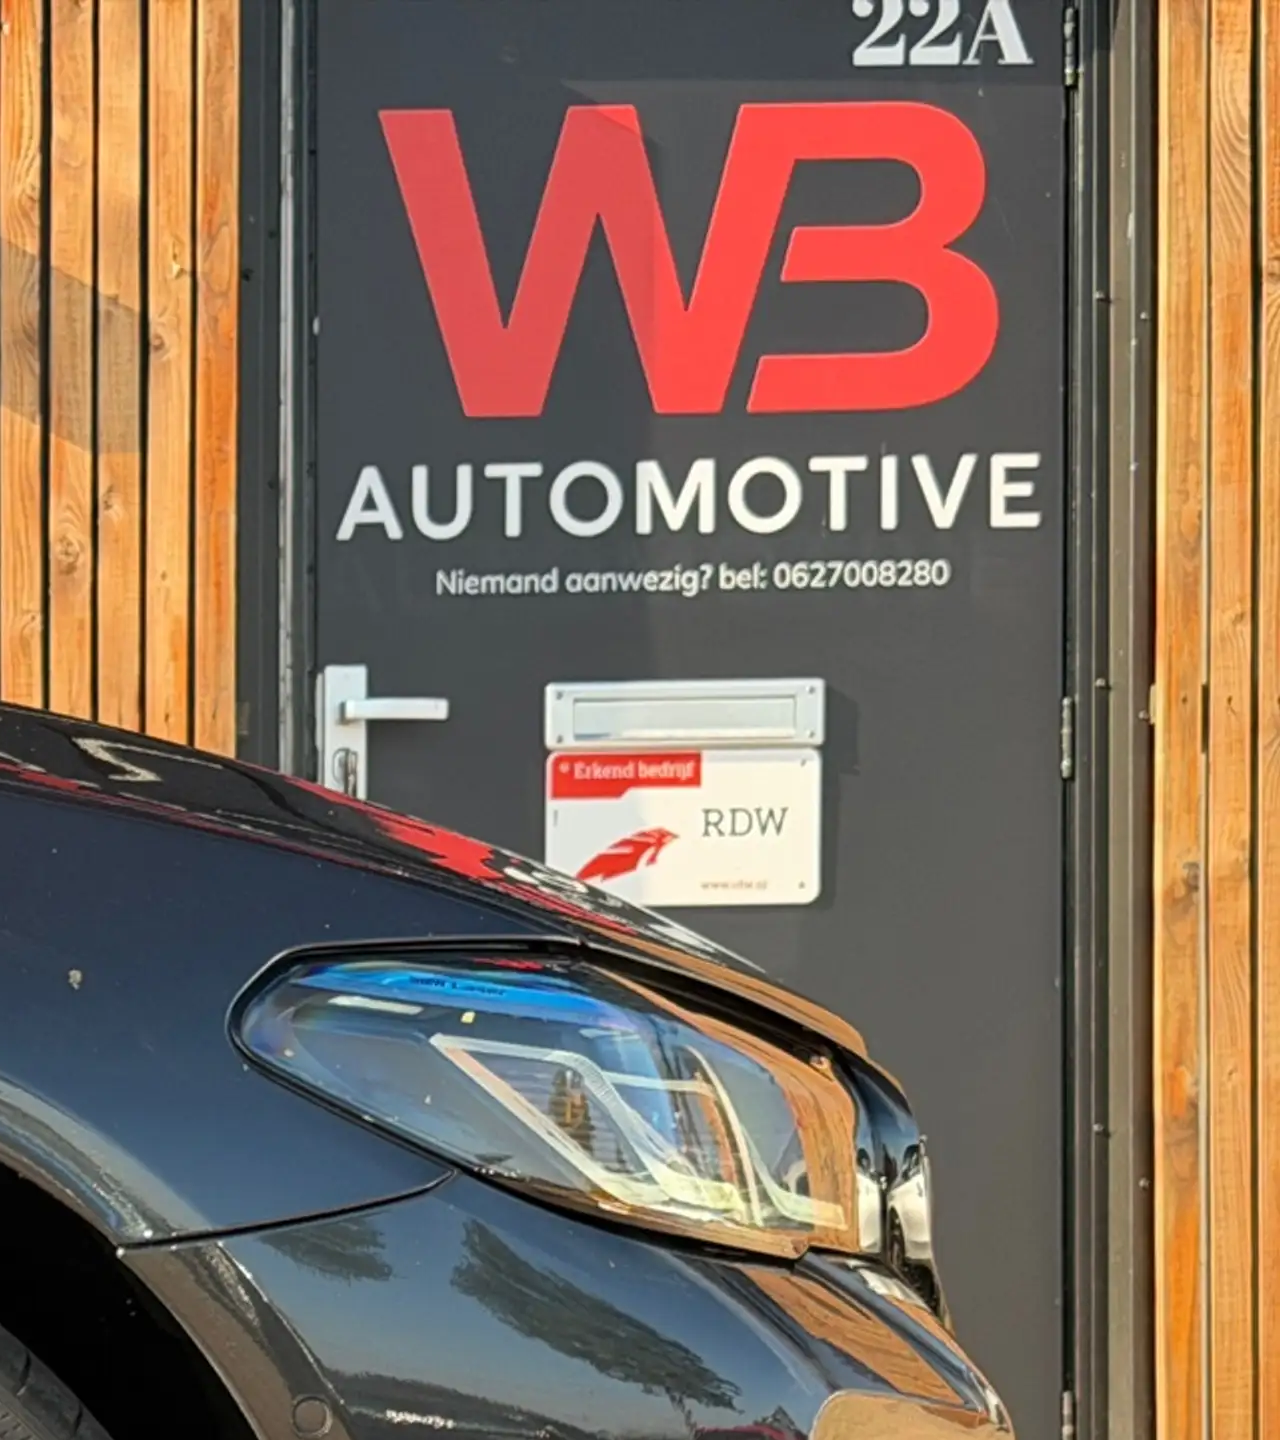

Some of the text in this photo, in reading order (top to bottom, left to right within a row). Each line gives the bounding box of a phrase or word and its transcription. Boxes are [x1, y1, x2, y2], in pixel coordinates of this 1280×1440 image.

[852, 0, 1035, 67] 22A
[377, 101, 1000, 418] WB
[335, 451, 1043, 542] AUTOMOTIVE
[435, 558, 952, 598] Niemand aanwezig? bel: 0627008280
[572, 759, 696, 781] Erkend bedrijf
[701, 807, 789, 838] RDW
